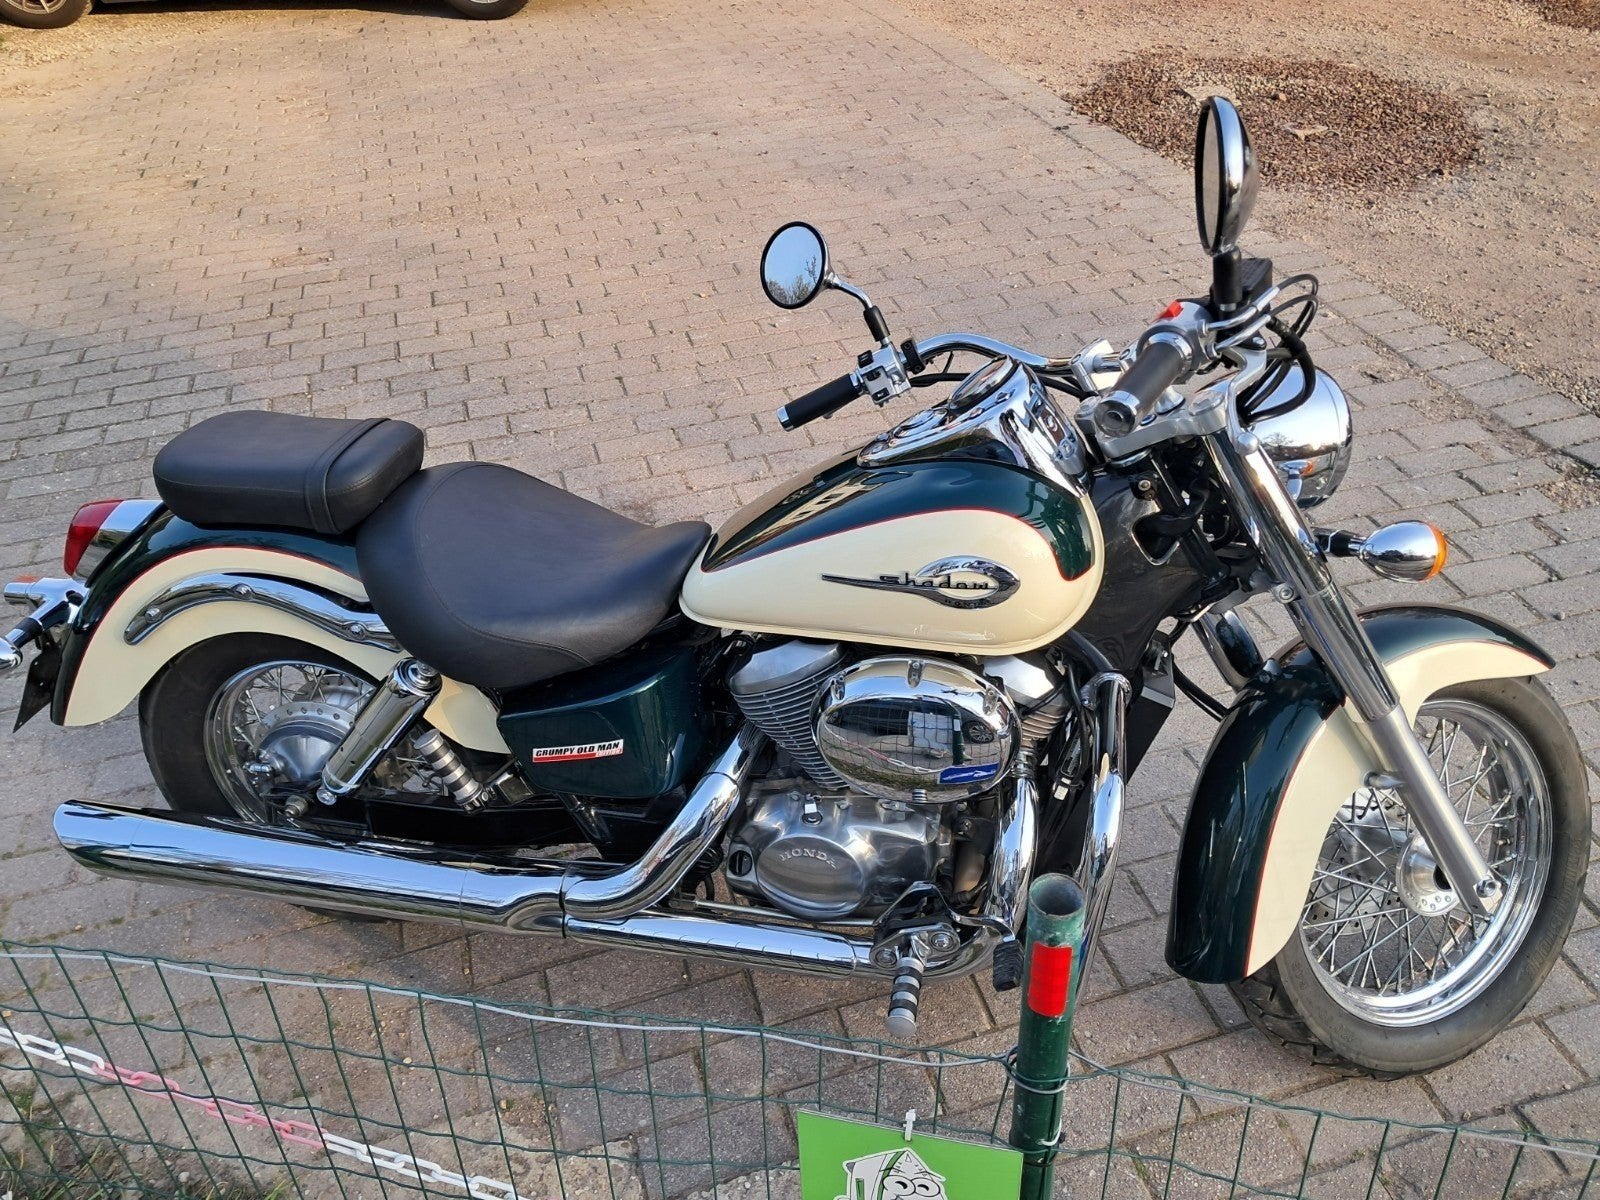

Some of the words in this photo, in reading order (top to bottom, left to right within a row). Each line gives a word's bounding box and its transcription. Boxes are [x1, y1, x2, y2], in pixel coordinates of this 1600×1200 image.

[536, 747, 575, 757] GRUMPY
[577, 745, 595, 754] OLD
[597, 741, 620, 752] MAN
